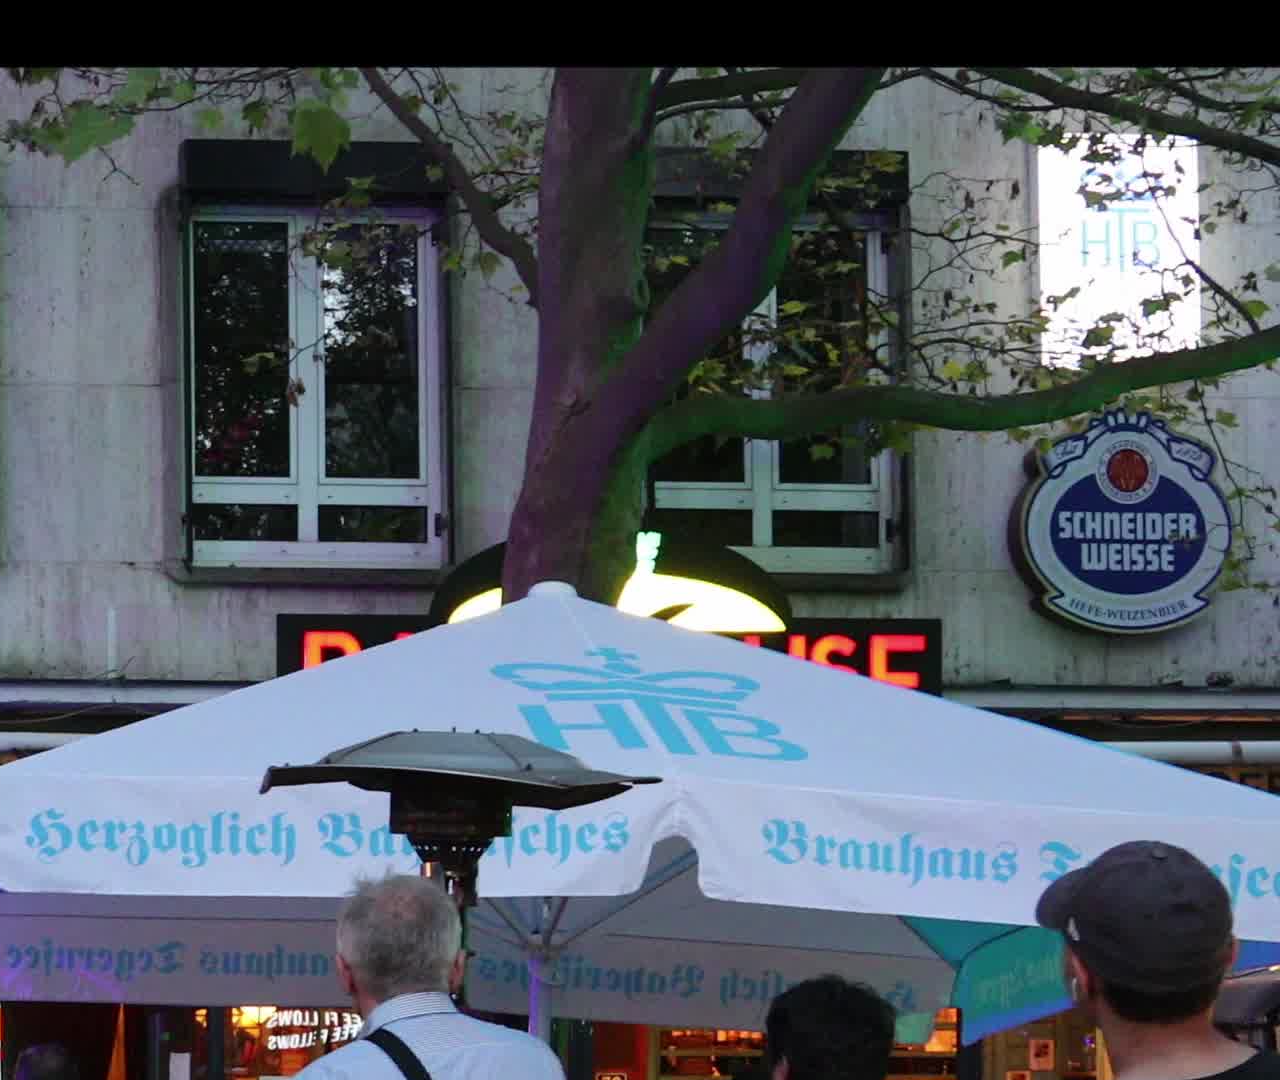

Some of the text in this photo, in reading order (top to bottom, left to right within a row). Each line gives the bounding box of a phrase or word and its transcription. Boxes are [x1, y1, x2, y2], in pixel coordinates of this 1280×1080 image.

[1058, 511, 1197, 540] SCHNEIDER
[1080, 543, 1175, 572] WEISSE
[517, 695, 808, 761] HTB
[24, 808, 298, 868] Herzoglich
[762, 818, 1020, 888] Brauhaus
